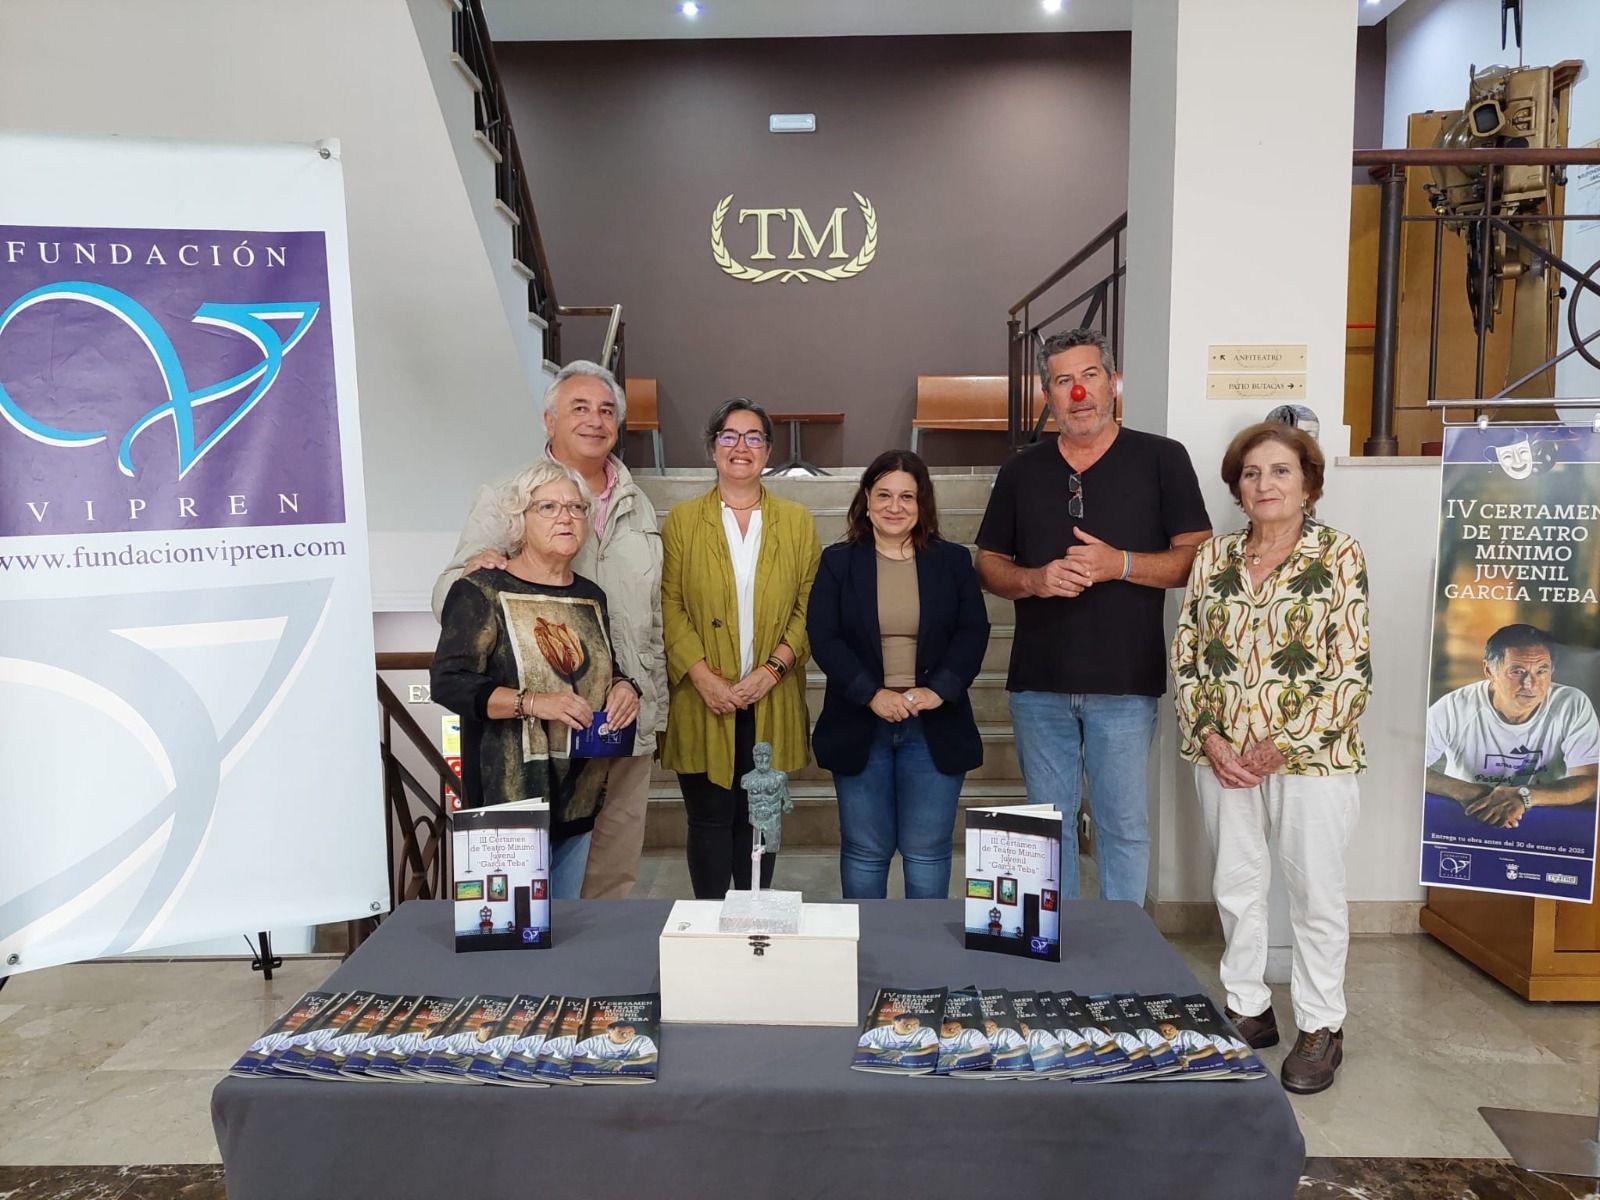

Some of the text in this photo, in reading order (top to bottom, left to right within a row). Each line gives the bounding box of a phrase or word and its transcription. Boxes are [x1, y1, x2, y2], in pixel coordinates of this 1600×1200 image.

[738, 207, 849, 260] TM
[6, 240, 288, 267] FUNDACIÓN
[27, 493, 300, 522] VIPREN
[1446, 499, 1478, 519] IV
[1462, 525, 1589, 542] DE TEATRO
[0, 540, 347, 572] www.fundacionvipren.com
[1475, 541, 1573, 562] MÍNIMO
[1474, 564, 1569, 583] JUVENIL
[1444, 582, 1599, 604] GARCÍA TEBA
[1000, 838, 1037, 849] Certamen
[1431, 832, 1457, 842] Entrega
[1467, 836, 1482, 844] obra
[993, 845, 1016, 855] Teatro
[1001, 854, 1026, 865] Juvenil
